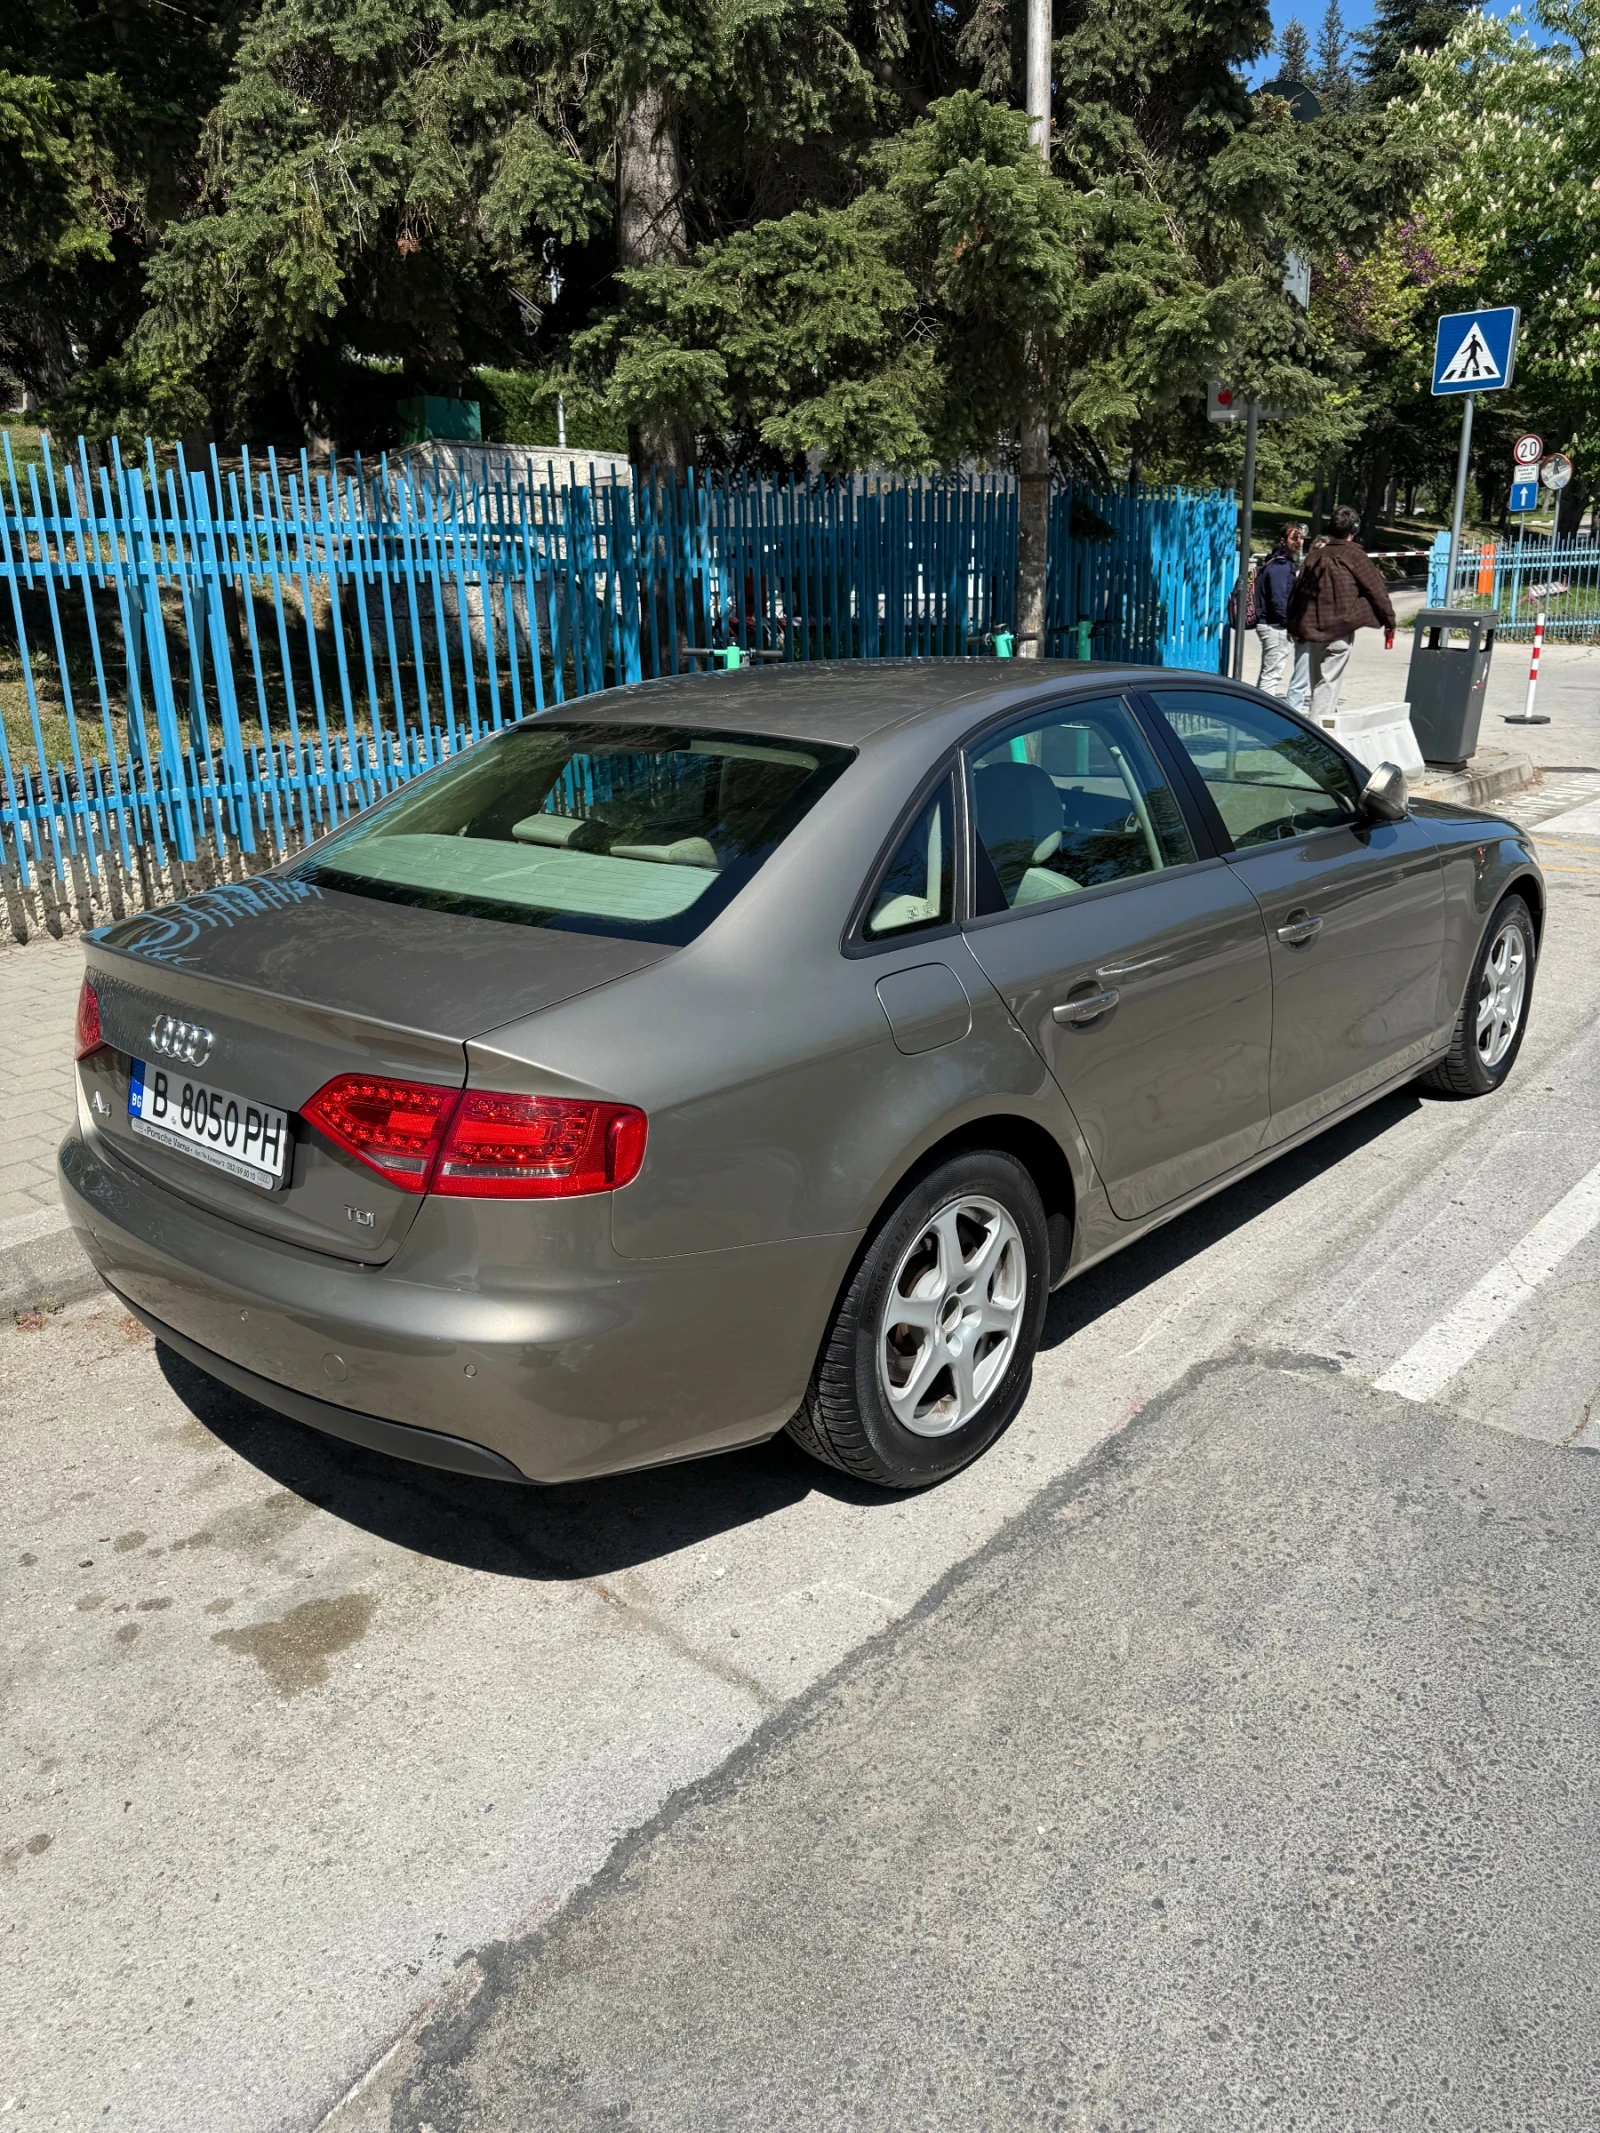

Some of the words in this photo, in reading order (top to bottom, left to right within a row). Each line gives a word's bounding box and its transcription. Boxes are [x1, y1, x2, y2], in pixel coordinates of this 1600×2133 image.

[1520, 441, 1537, 458] 20
[92, 1090, 112, 1117] A4
[131, 1092, 142, 1108] BG
[153, 1071, 168, 1118] B
[180, 1083, 239, 1147] 8050
[243, 1106, 282, 1167] PH
[344, 1204, 375, 1228] TDI
[867, 1275, 886, 1324] 225/55
